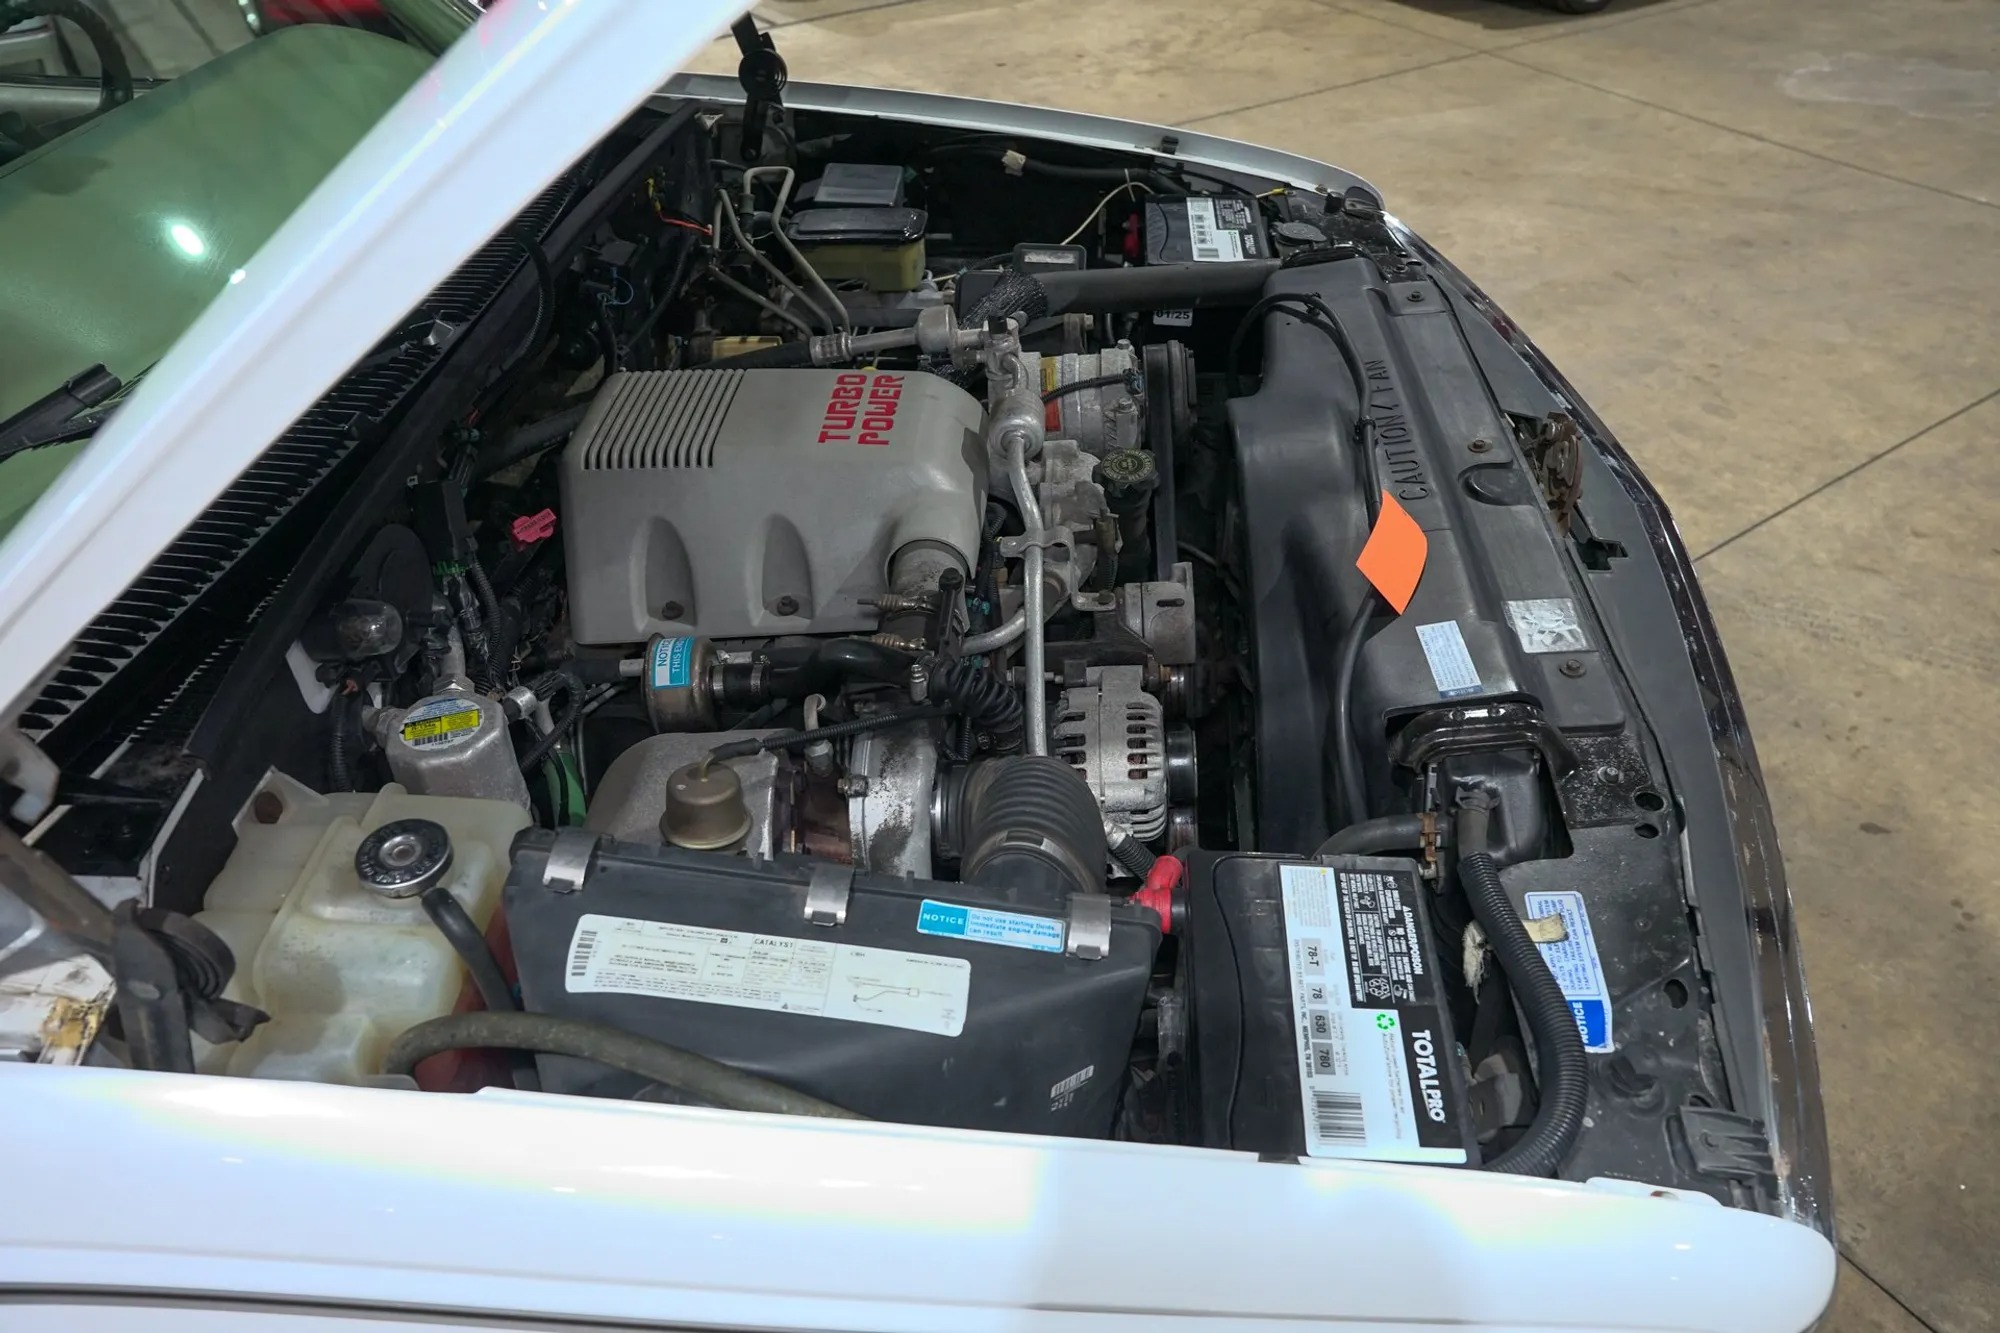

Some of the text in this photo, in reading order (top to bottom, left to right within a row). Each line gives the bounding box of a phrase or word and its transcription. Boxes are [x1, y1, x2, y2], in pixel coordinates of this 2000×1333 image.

[818, 374, 867, 443] TURBO
[858, 375, 905, 445] POWER
[671, 651, 681, 673] THIS
[922, 912, 965, 926] NOTICE
[1306, 945, 1319, 966] 78-T
[1311, 987, 1323, 999] 78
[1314, 1014, 1327, 1034] 630
[1572, 1001, 1589, 1043] NOTICE
[1318, 1048, 1331, 1068] 780
[1412, 1029, 1446, 1122] TOTALPRO
